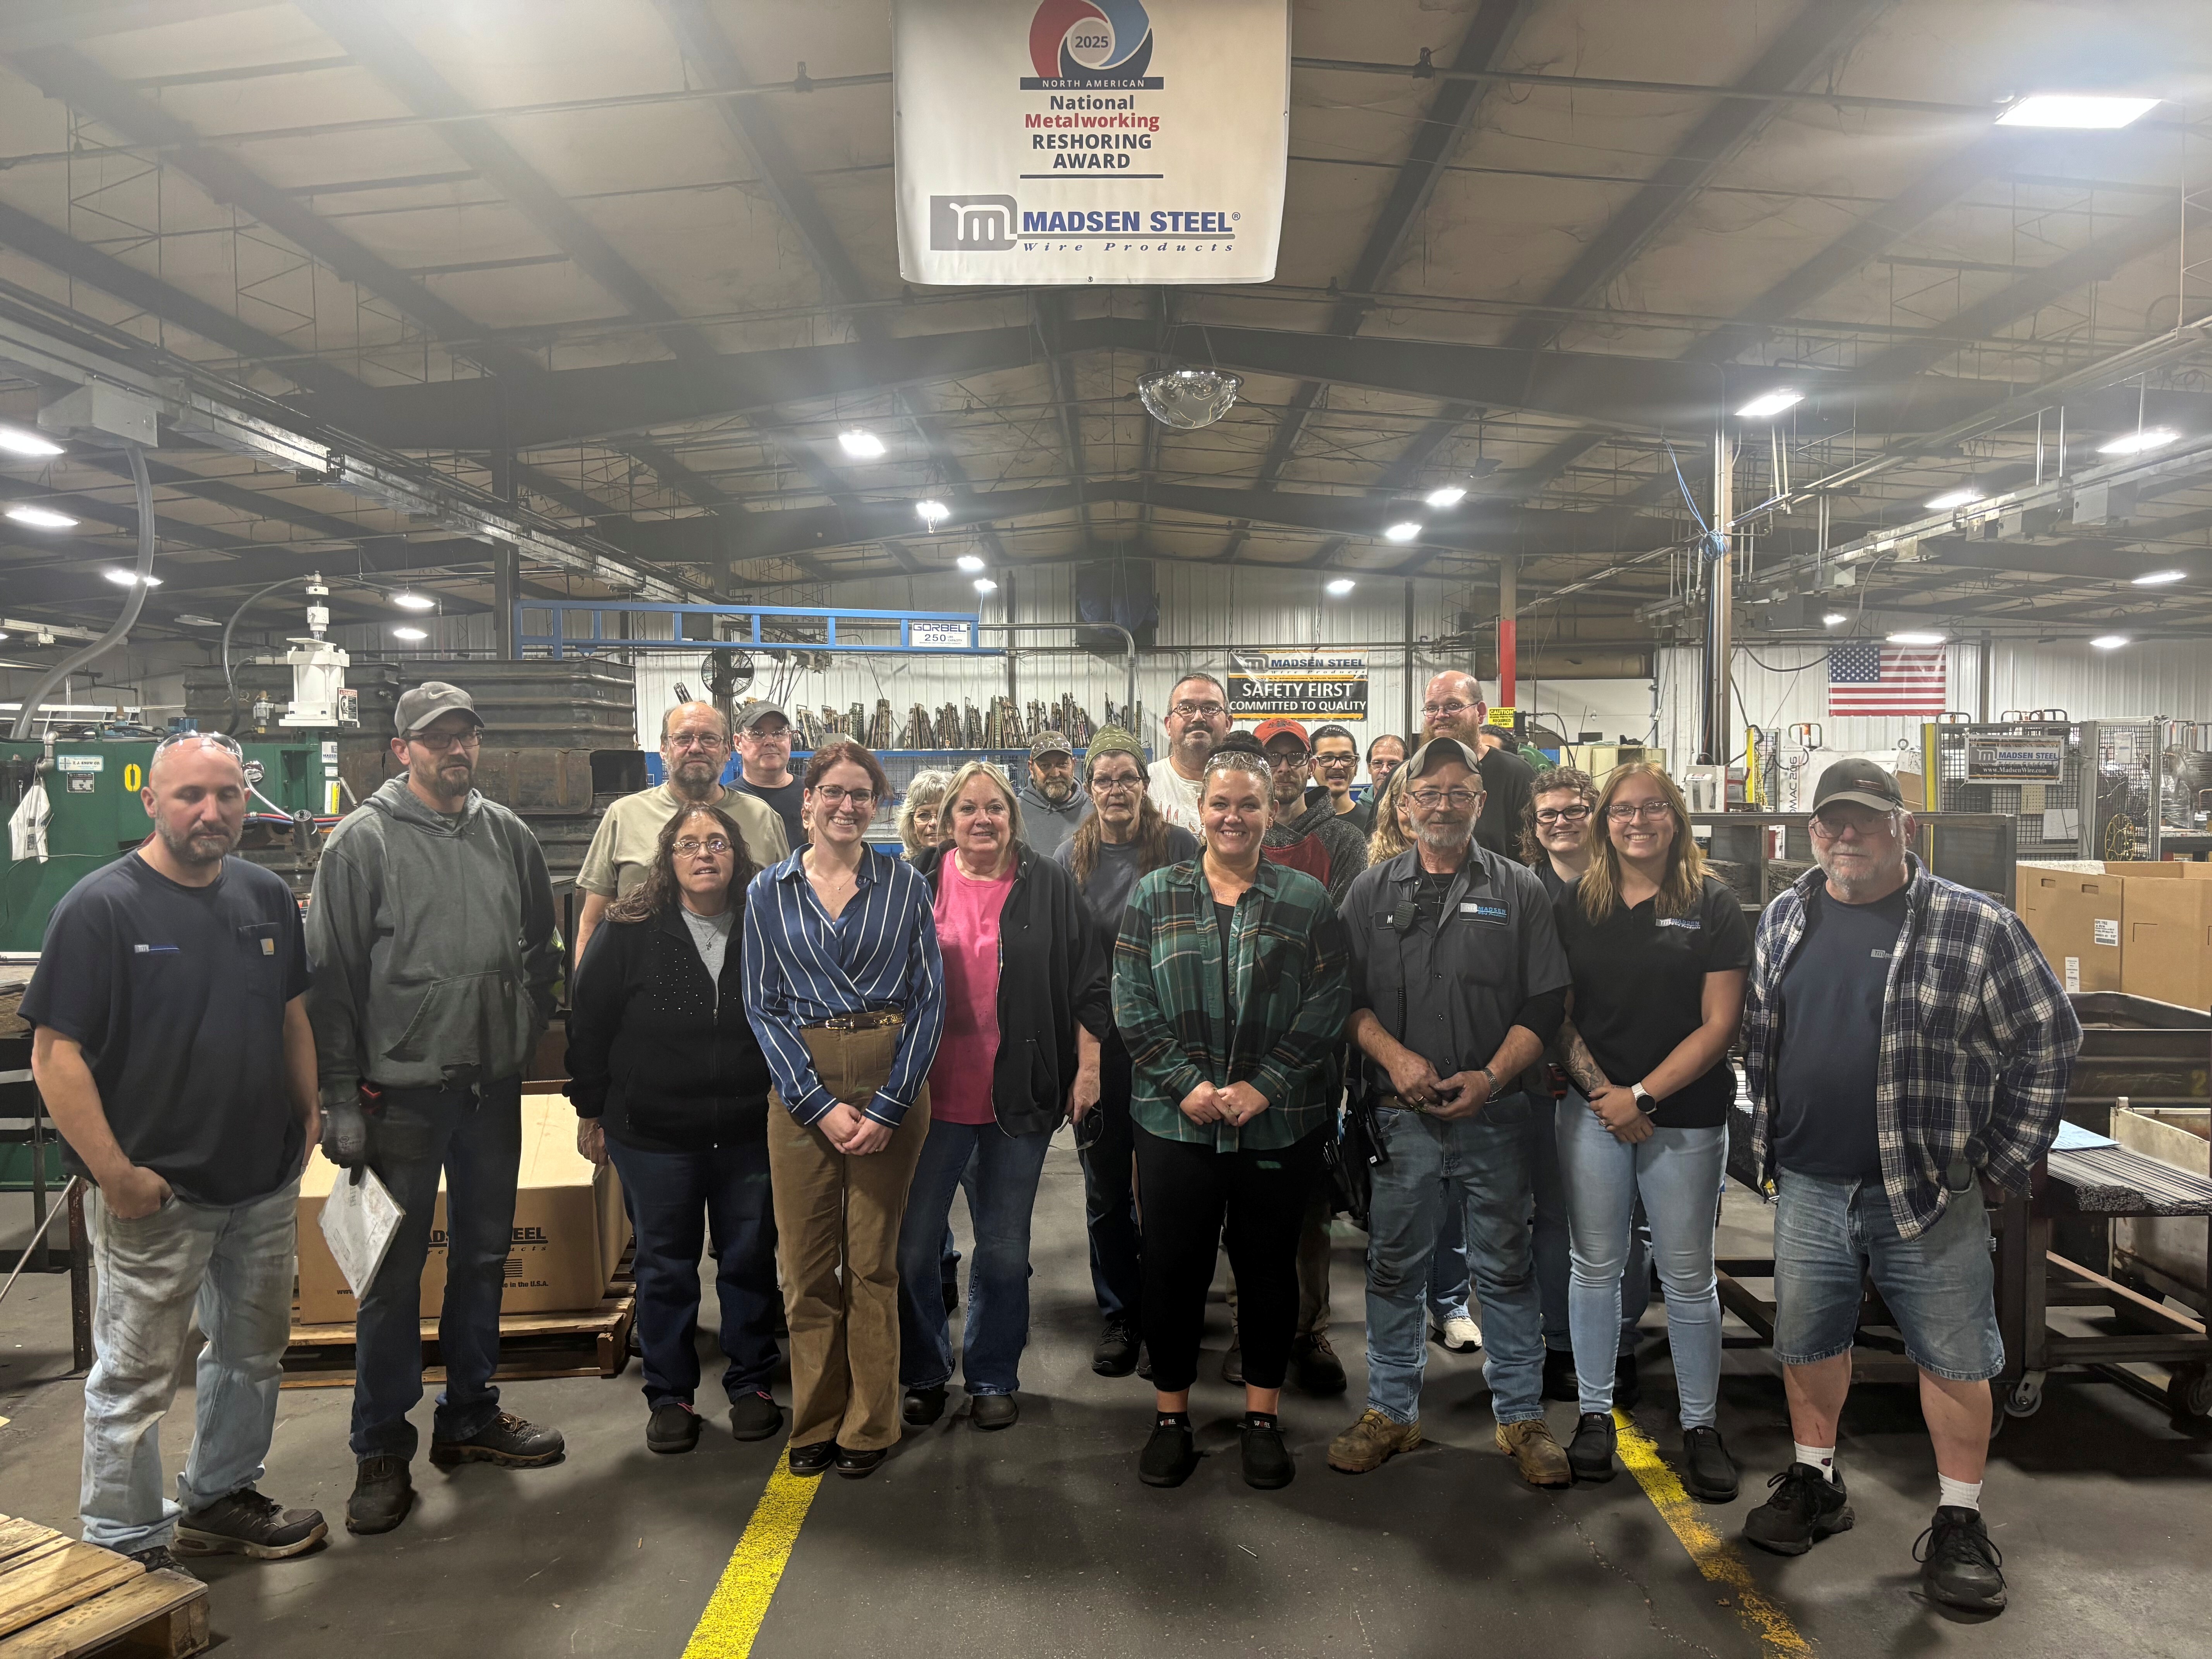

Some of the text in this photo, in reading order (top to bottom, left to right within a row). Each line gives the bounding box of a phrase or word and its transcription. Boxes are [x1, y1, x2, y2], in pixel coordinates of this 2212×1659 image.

[1075, 36, 1109, 48] 2025
[1050, 94, 1134, 110] National
[1025, 113, 1159, 132] Metalworking
[1033, 134, 1151, 149] RESHORING
[1053, 154, 1130, 168] AWARD
[1023, 211, 1140, 232] MADSEN
[1024, 242, 1233, 251] Wire Products
[913, 623, 966, 632] GORBEL
[1242, 683, 1353, 697] SAFETY FIRST
[1229, 701, 1367, 712] COMMITTED TO QUALITY
[1789, 756, 1797, 780] 206
